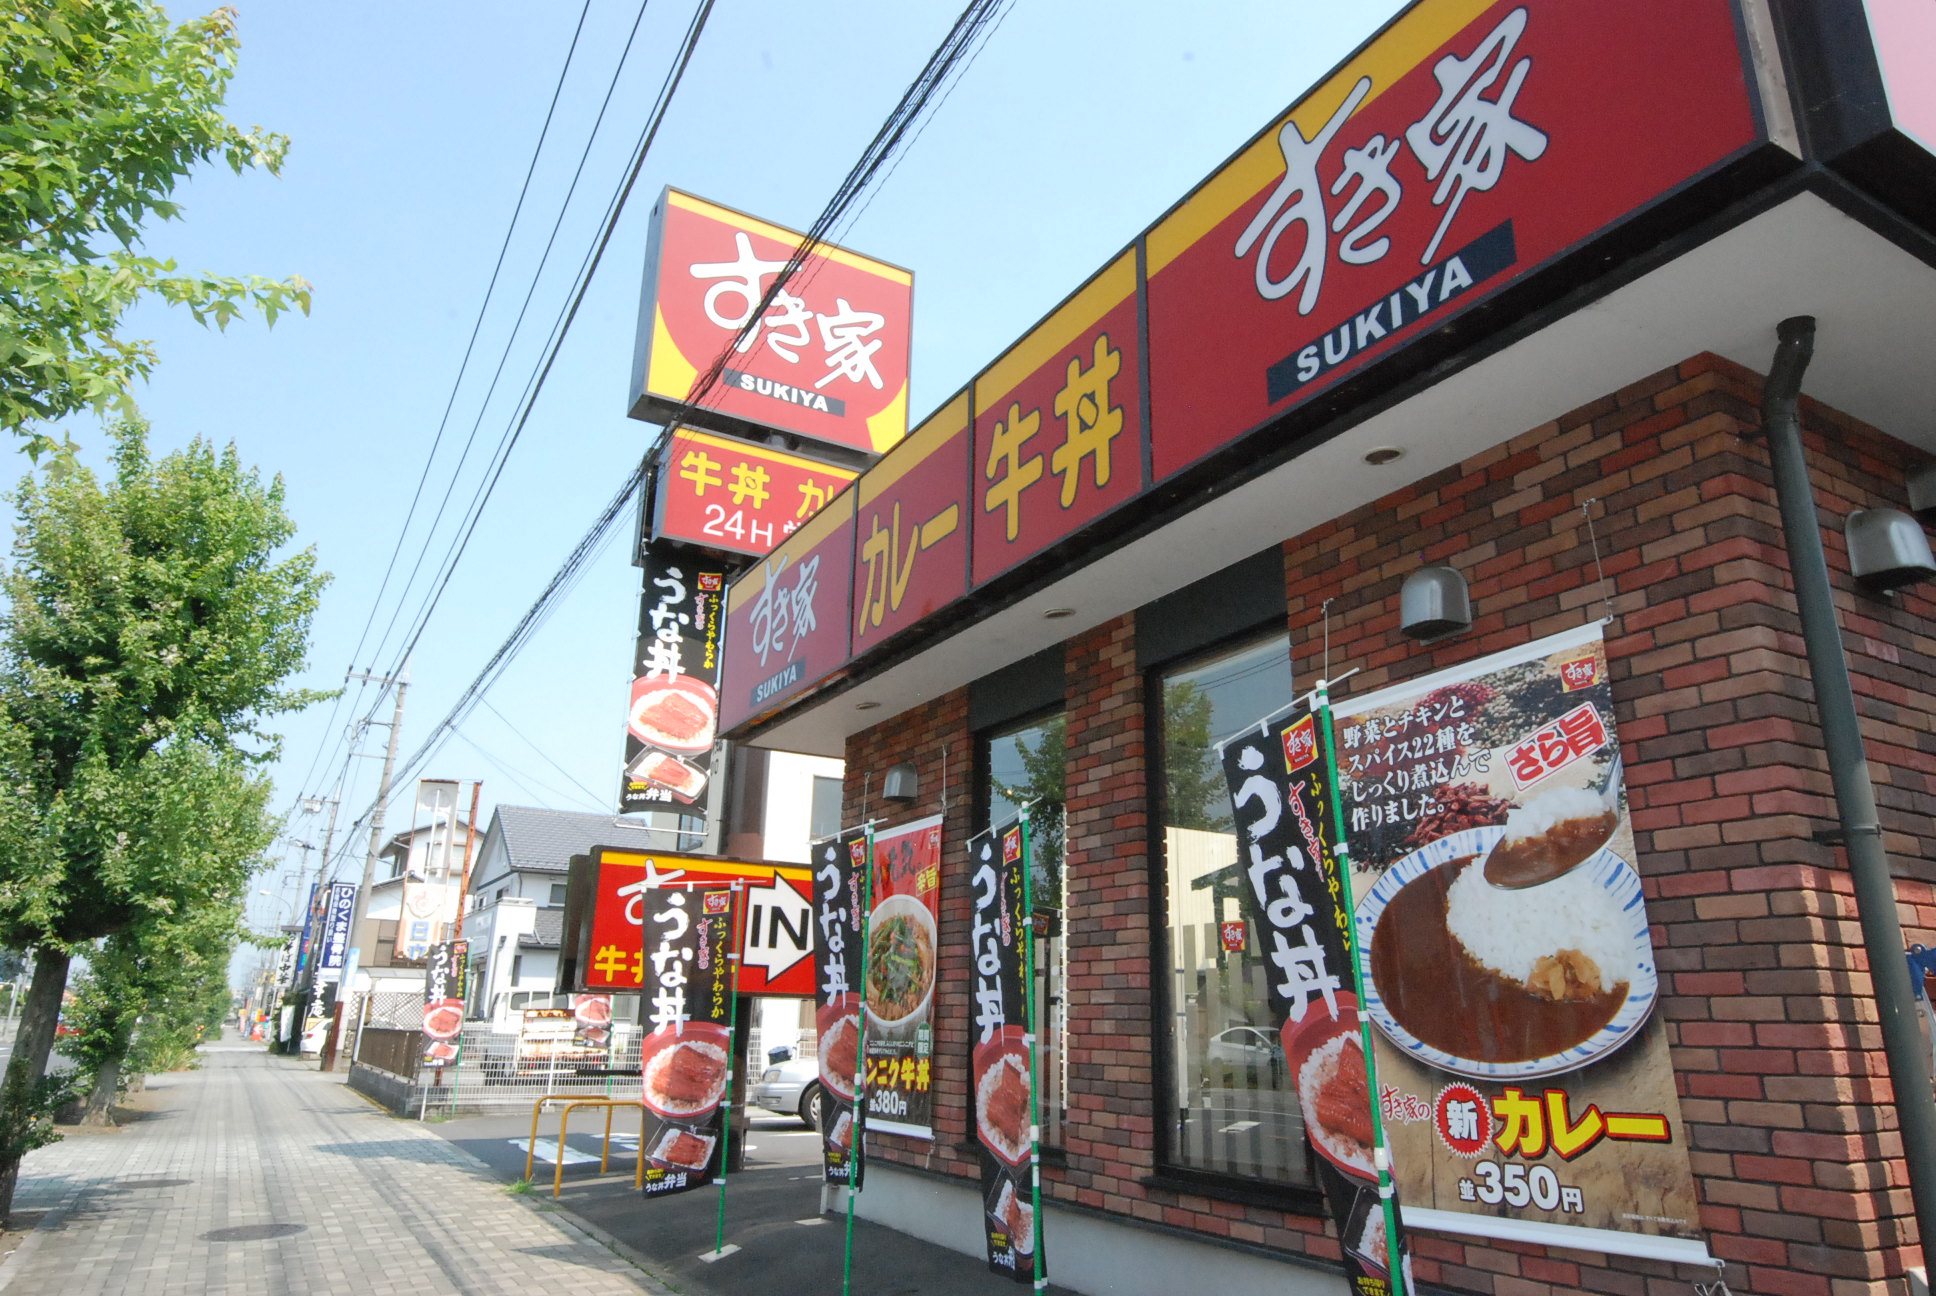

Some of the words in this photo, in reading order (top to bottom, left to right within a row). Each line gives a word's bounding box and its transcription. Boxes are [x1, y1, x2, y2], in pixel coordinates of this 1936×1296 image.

[1234, 6, 1550, 316] すき家
[689, 232, 886, 390] すき家
[1296, 256, 1474, 382] SUKIYA
[740, 374, 829, 413] SUKIYA
[985, 333, 1124, 543] 牛丼
[680, 450, 771, 509] 牛丼
[702, 504, 773, 547] 24H
[859, 501, 959, 636] カレー
[643, 566, 689, 685] うな丼
[703, 593, 719, 669] ふっくらやわらか
[749, 553, 820, 668] すき家
[756, 664, 797, 703] SUKIYA
[1565, 662, 1594, 680] すき家
[1286, 728, 1314, 758] すき家
[1342, 695, 1466, 750] 野菜とチキンと
[1348, 721, 1475, 773] スパイス22種を
[1508, 708, 1605, 783] さら旨
[1351, 748, 1492, 802] じっくり煮込んで
[1350, 795, 1446, 832] 作りました。
[1234, 745, 1341, 1023] うな丼
[1310, 772, 1354, 974] ふっくらやわら
[650, 892, 693, 1037] うな丼
[750, 904, 809, 951] IN
[816, 846, 850, 1009] うな丼
[971, 843, 1005, 1048] うな丼
[428, 944, 450, 1006] うな丼
[711, 917, 727, 1019] ふっくらやわらか
[1382, 1084, 1431, 1125] すき家の
[1445, 1100, 1478, 1141] 新
[1491, 1087, 1671, 1161] カレー
[645, 1171, 688, 1193] うな丼弁当
[1459, 1161, 1583, 1214] 並350円
